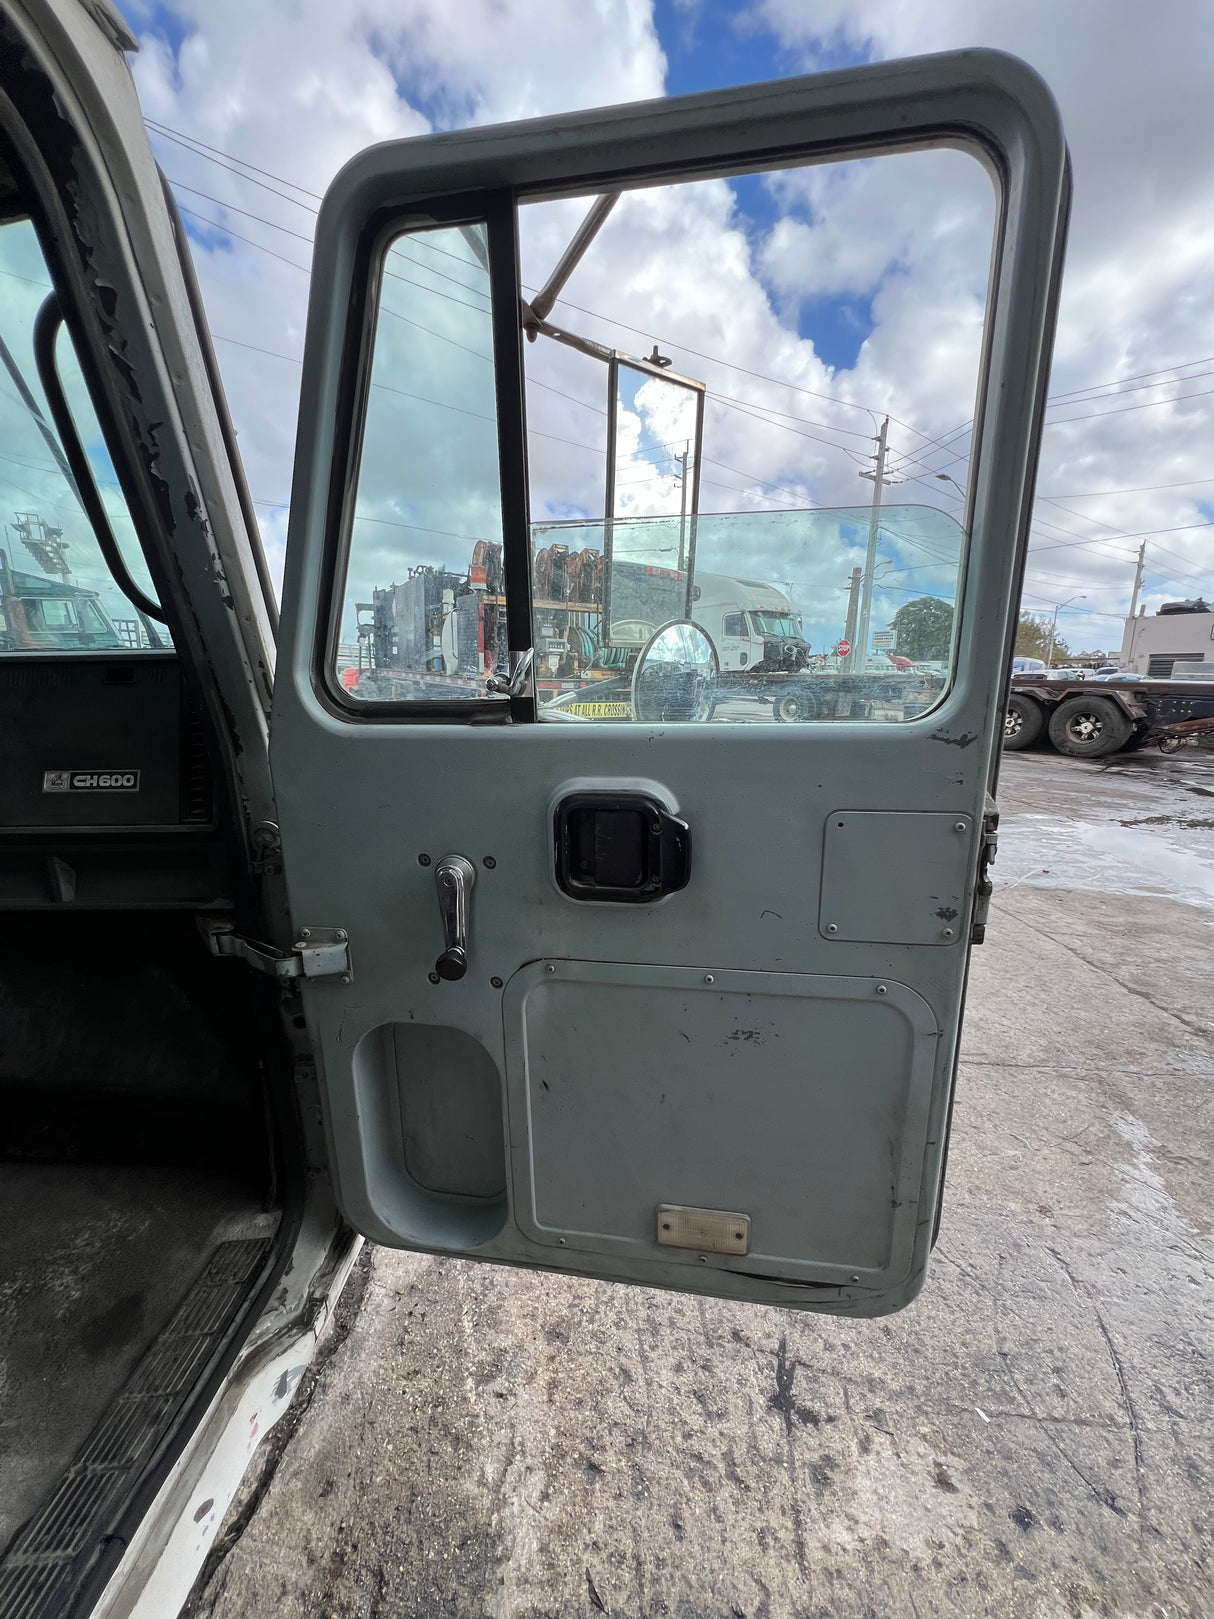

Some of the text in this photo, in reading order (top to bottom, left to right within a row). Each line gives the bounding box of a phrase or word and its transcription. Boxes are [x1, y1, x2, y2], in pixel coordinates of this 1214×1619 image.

[574, 704, 581, 717] AT
[582, 704, 591, 717] ALL
[73, 775, 135, 787] CH600
